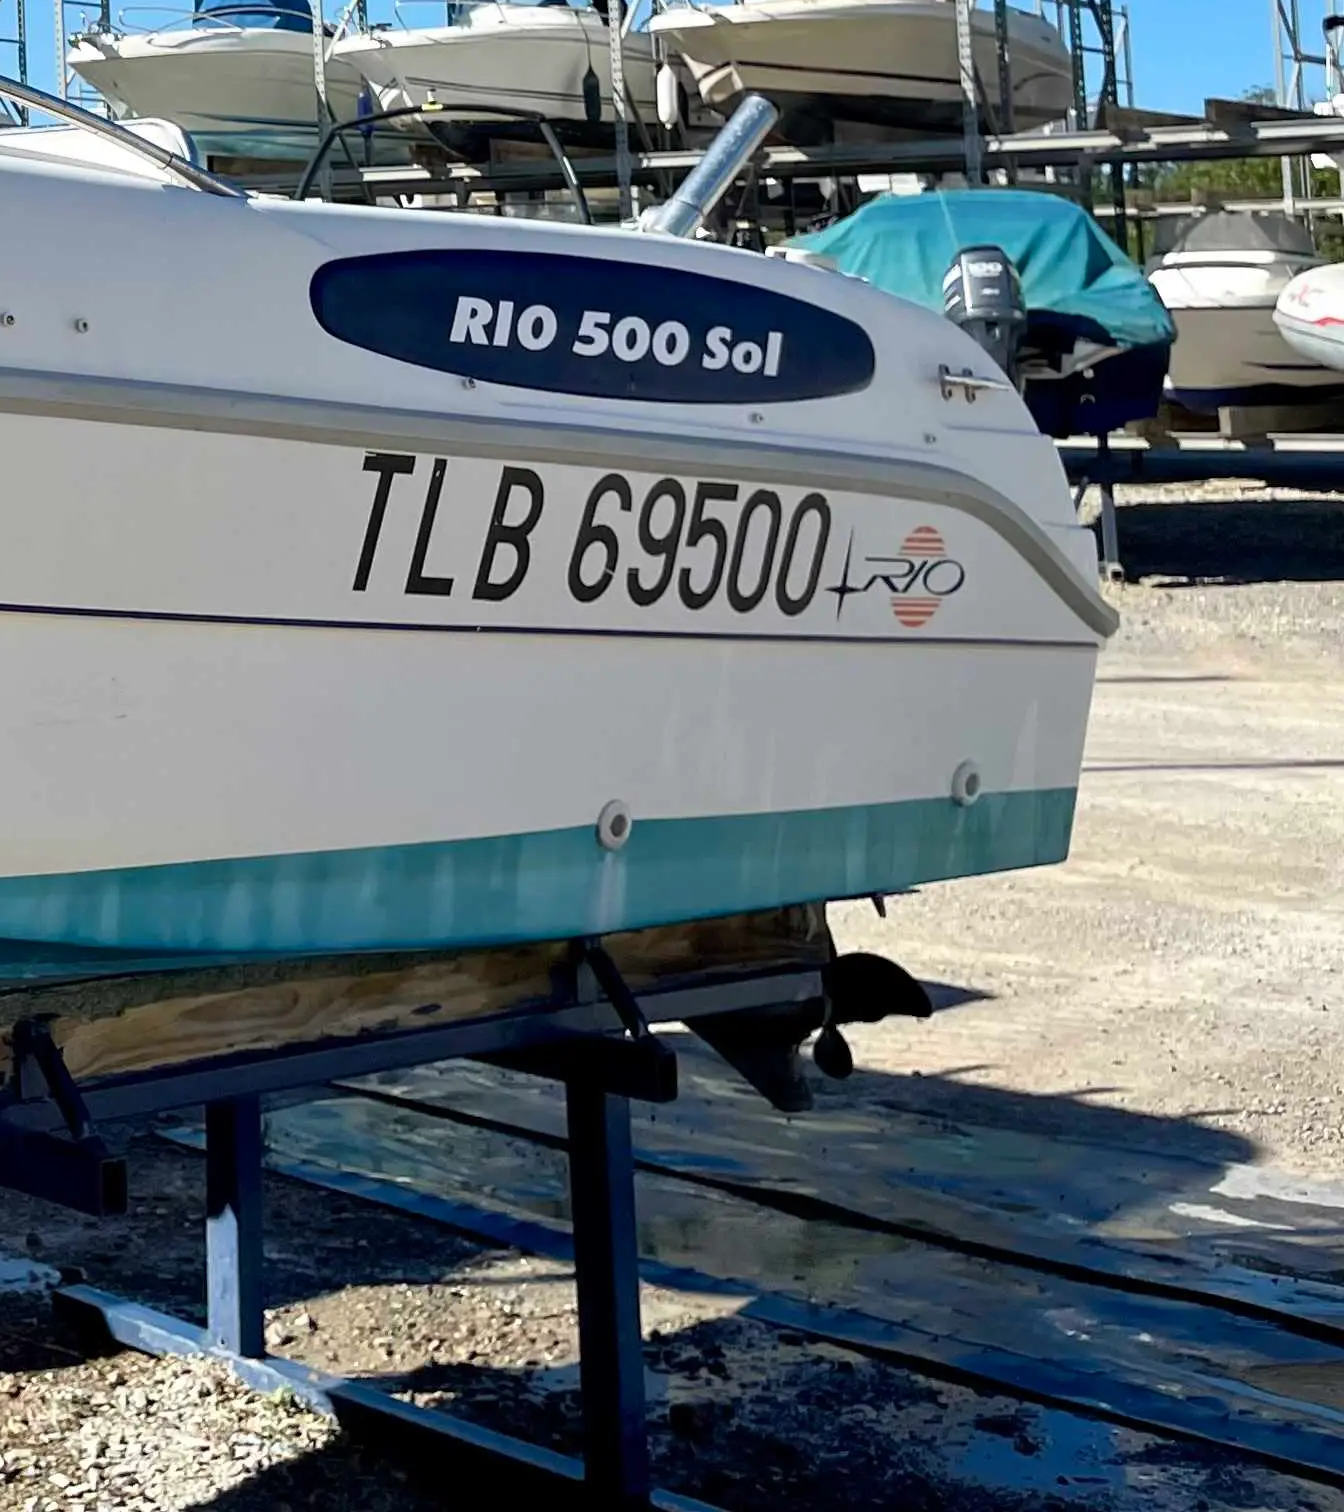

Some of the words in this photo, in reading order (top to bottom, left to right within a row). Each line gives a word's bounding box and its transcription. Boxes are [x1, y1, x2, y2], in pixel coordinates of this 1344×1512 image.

[450, 296, 557, 351] RIO
[572, 310, 690, 366] 500
[702, 326, 783, 377] Sol
[353, 451, 544, 601] TLB
[568, 473, 831, 616] 69500
[862, 557, 965, 596] RIO
